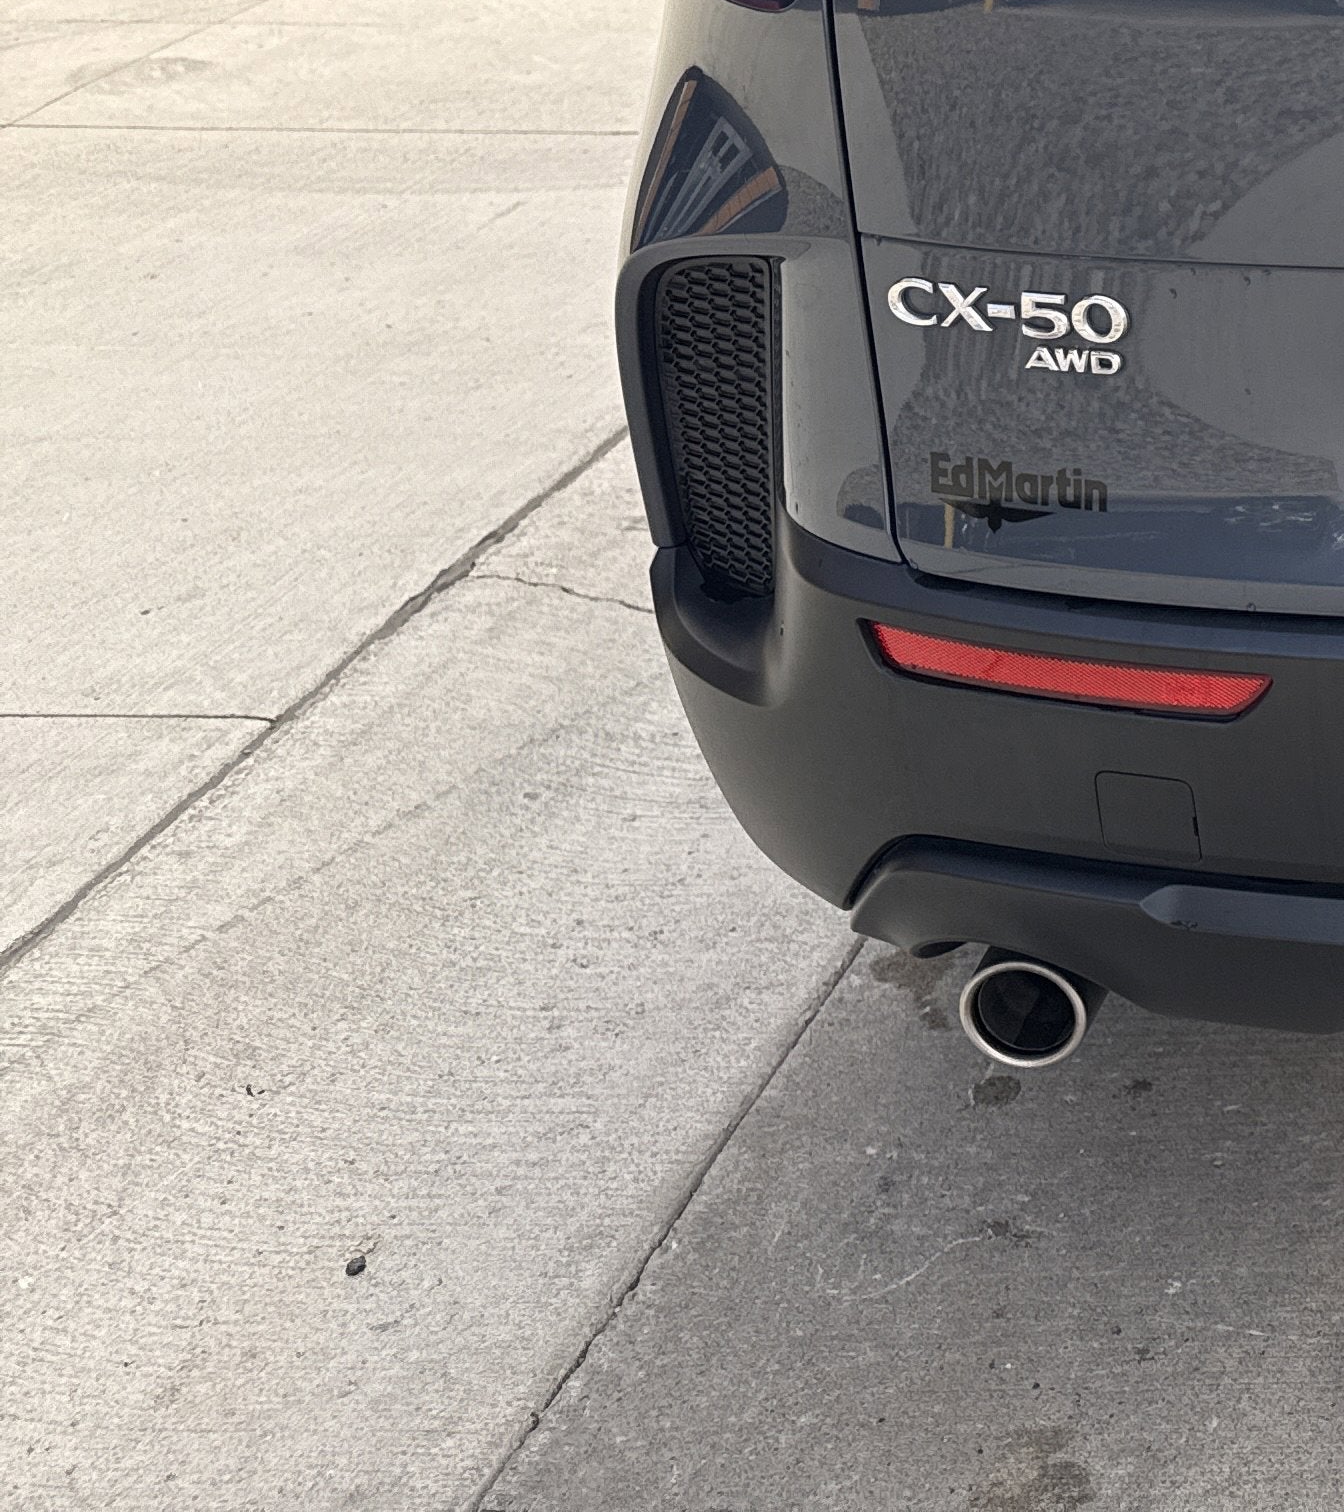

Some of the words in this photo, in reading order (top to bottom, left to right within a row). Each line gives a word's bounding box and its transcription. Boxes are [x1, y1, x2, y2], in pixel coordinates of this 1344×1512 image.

[887, 277, 1130, 344] CX-50
[1025, 346, 1122, 375] AWD
[929, 451, 1108, 512] EdMartin
